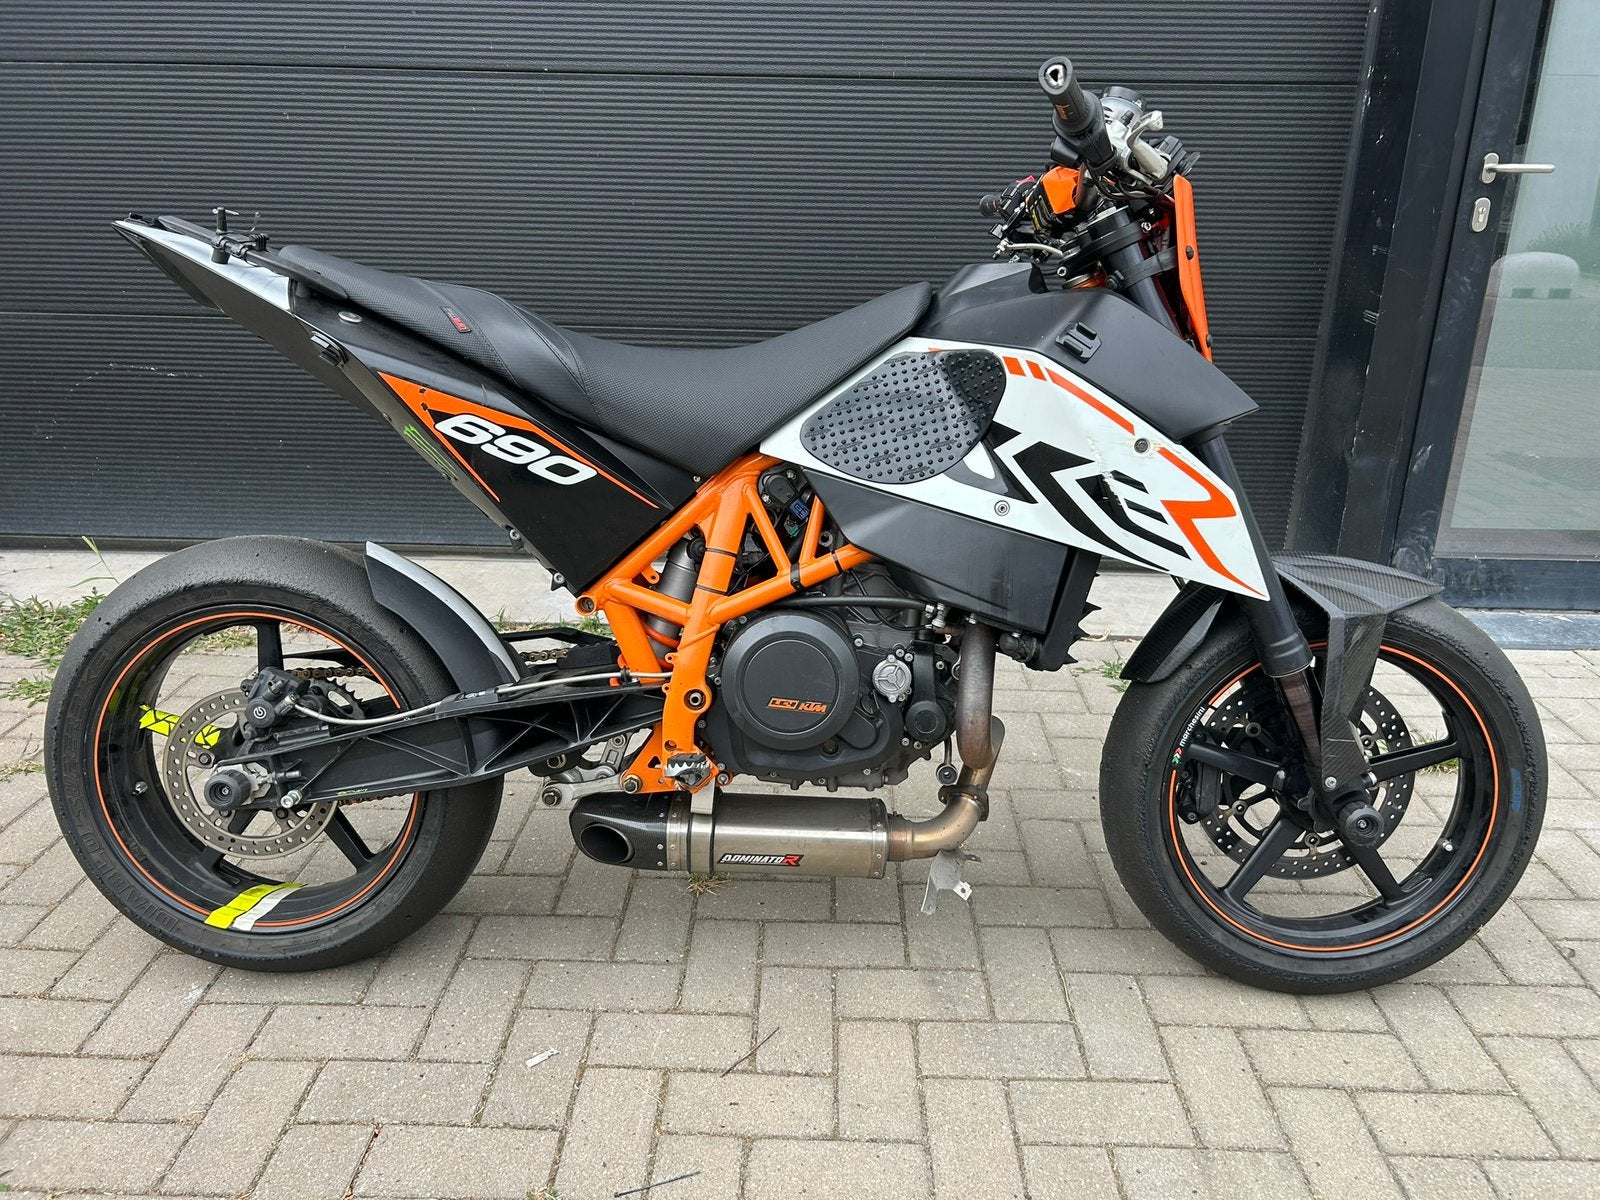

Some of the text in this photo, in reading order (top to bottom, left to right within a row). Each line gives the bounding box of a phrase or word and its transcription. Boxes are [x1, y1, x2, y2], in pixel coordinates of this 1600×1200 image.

[434, 413, 598, 486] 690
[799, 701, 828, 714] KTM
[720, 854, 800, 867] DOMINATOR
